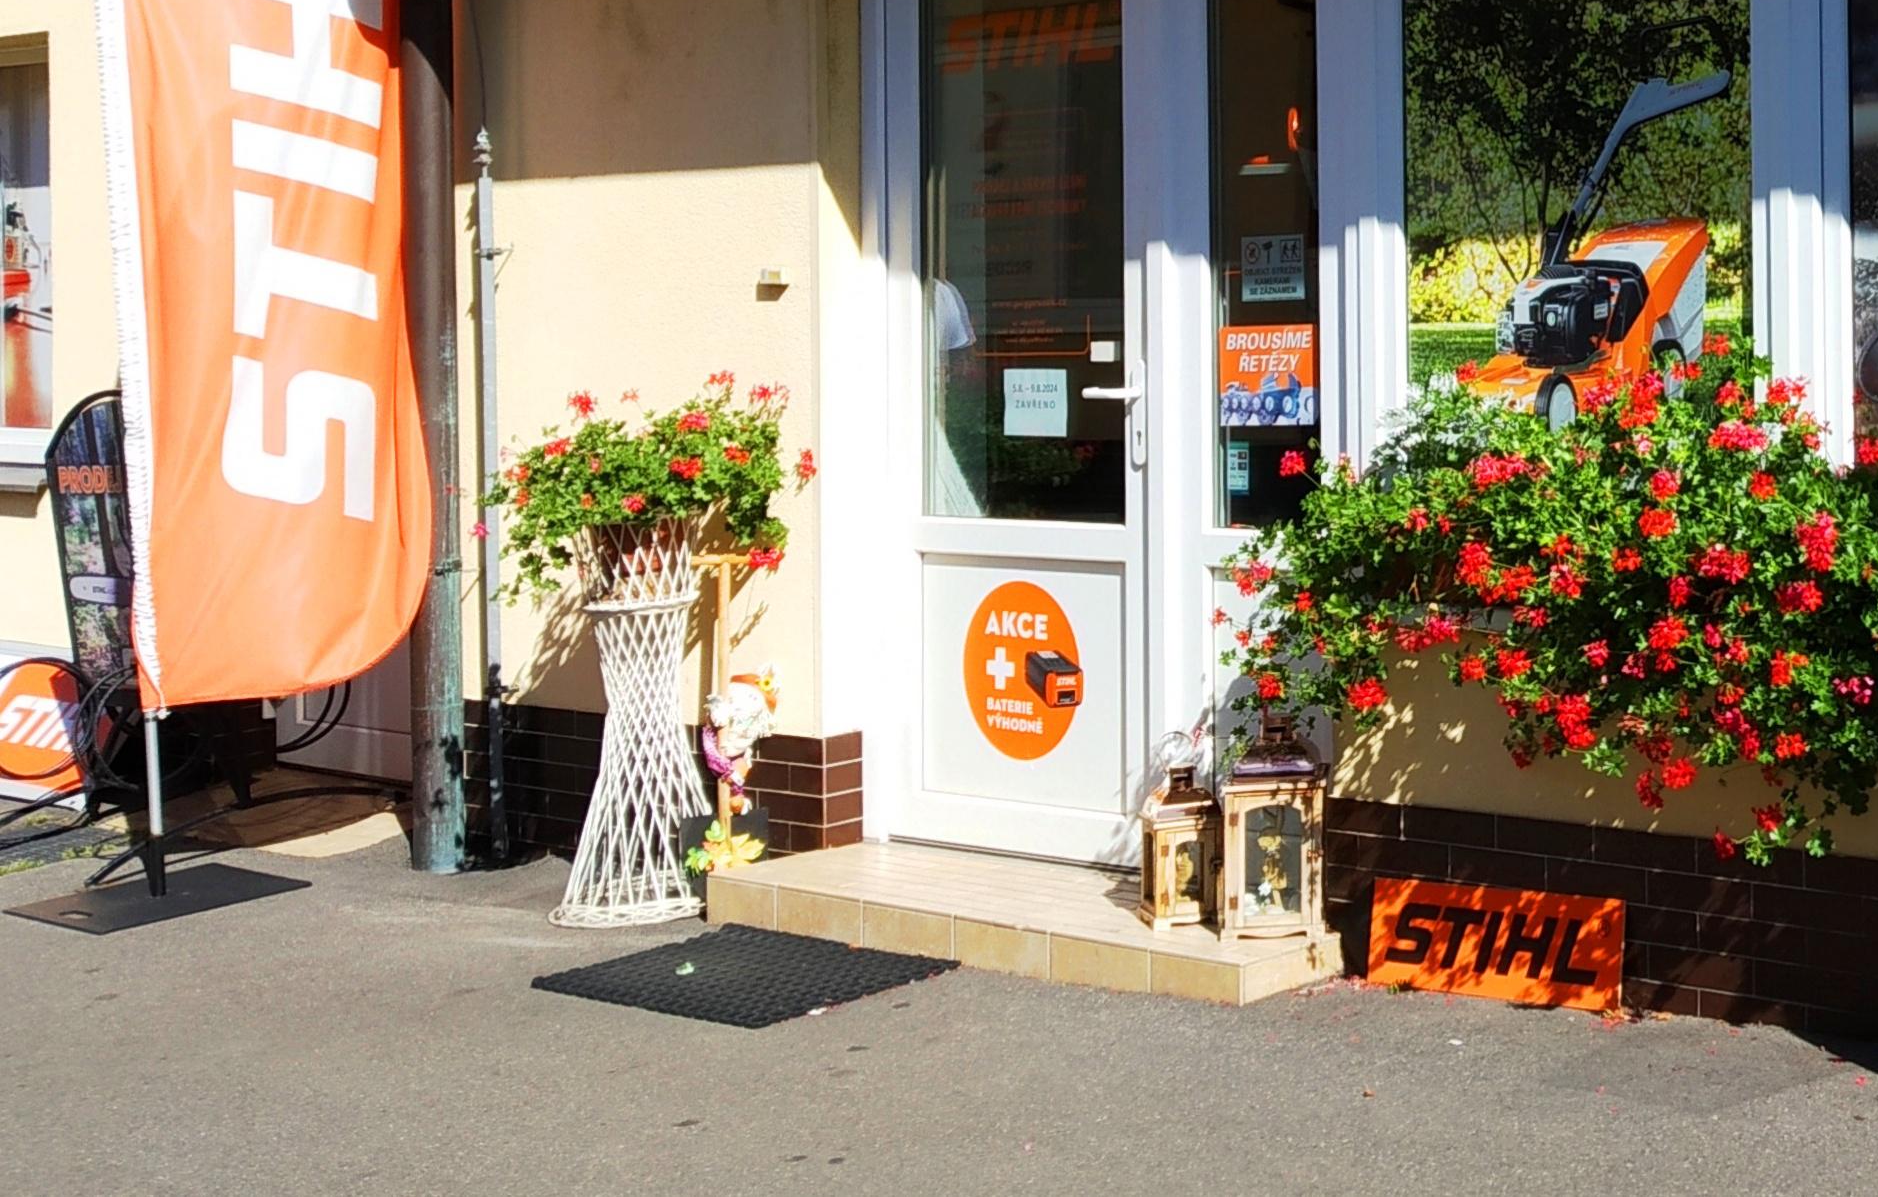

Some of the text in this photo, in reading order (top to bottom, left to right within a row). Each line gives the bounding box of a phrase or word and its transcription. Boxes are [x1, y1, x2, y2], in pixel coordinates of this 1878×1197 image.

[940, 0, 1116, 75] STIHL
[1226, 328, 1312, 351] BROUSÍME
[1238, 351, 1301, 373] ŘETĚZY
[1015, 399, 1056, 409] ZAVŘENO
[57, 465, 122, 495] PRODEJ
[985, 610, 1048, 640] AKCE
[986, 696, 1033, 715] BATERIE
[986, 713, 1043, 734] VÝHODNĚ
[1384, 902, 1598, 986] STIHL
